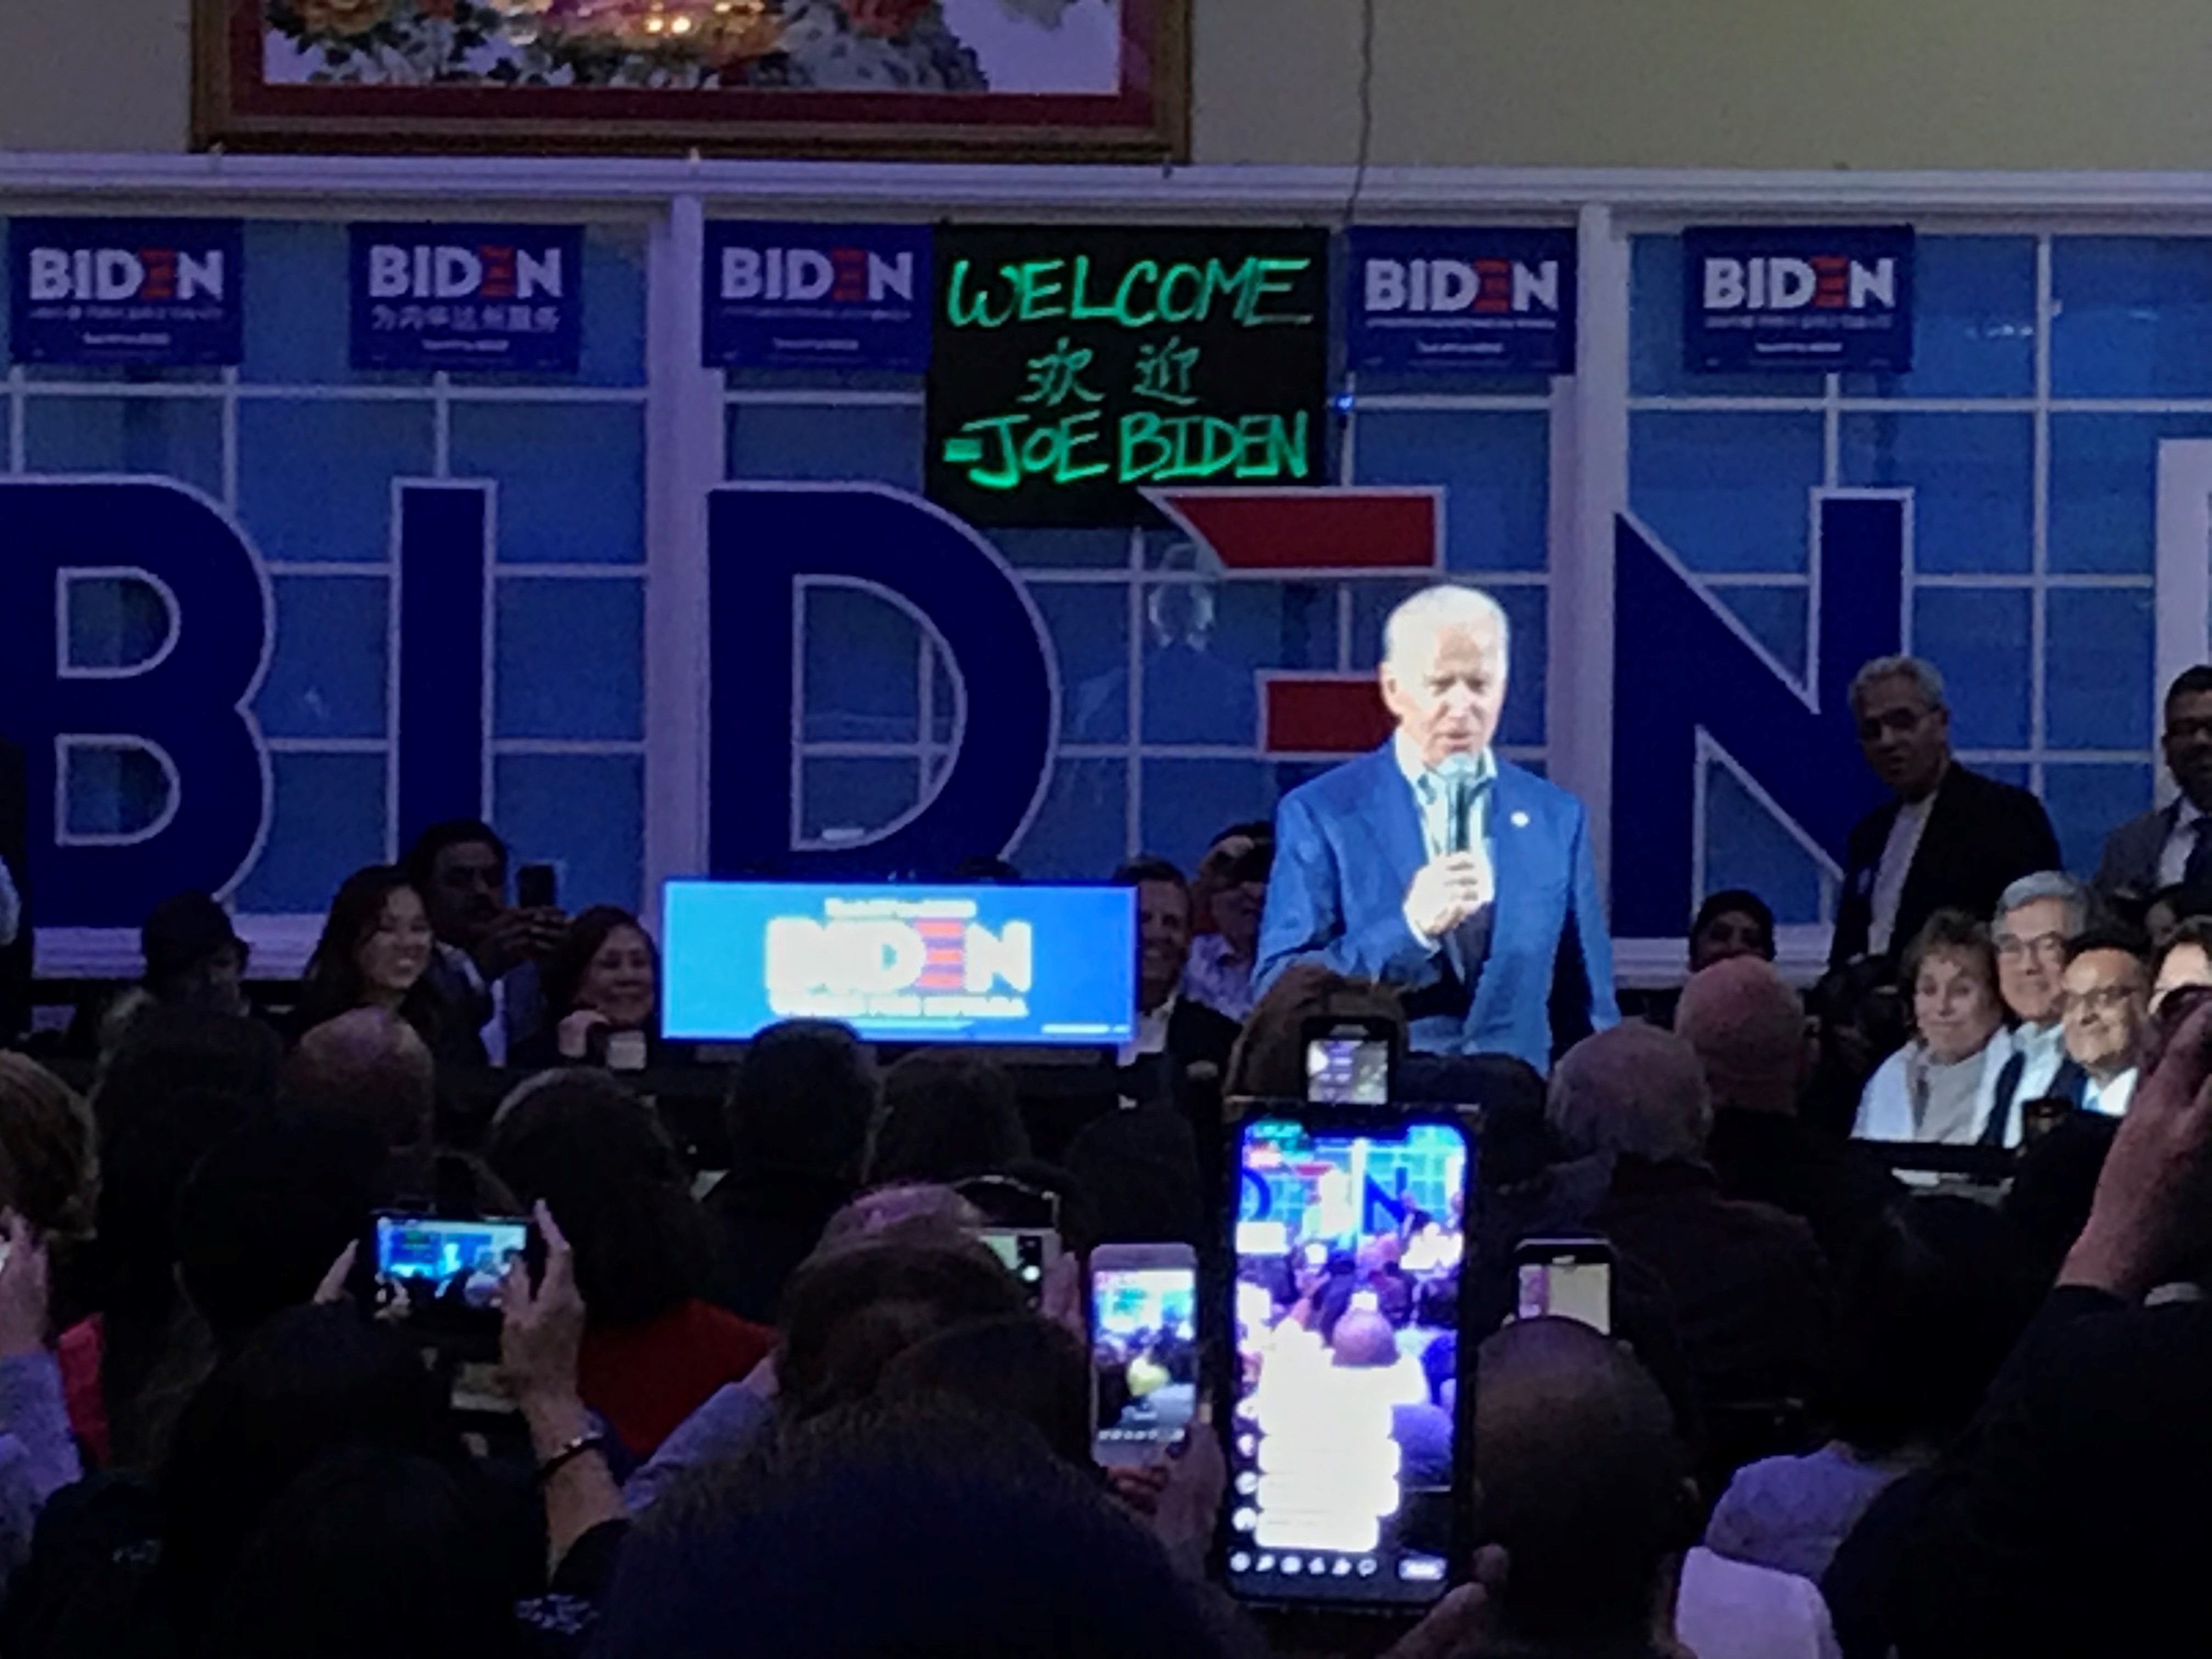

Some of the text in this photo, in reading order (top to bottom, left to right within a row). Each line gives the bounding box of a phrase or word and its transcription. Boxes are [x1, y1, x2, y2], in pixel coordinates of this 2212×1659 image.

[29, 246, 224, 301] BIDEN
[369, 244, 562, 298] BIDEN
[720, 246, 913, 301] BIDEN
[947, 256, 1313, 327] WELCOME
[1365, 259, 1559, 312] BIDEN
[1703, 255, 1897, 309] BIDEN
[1118, 409, 1309, 483] BIDEN
